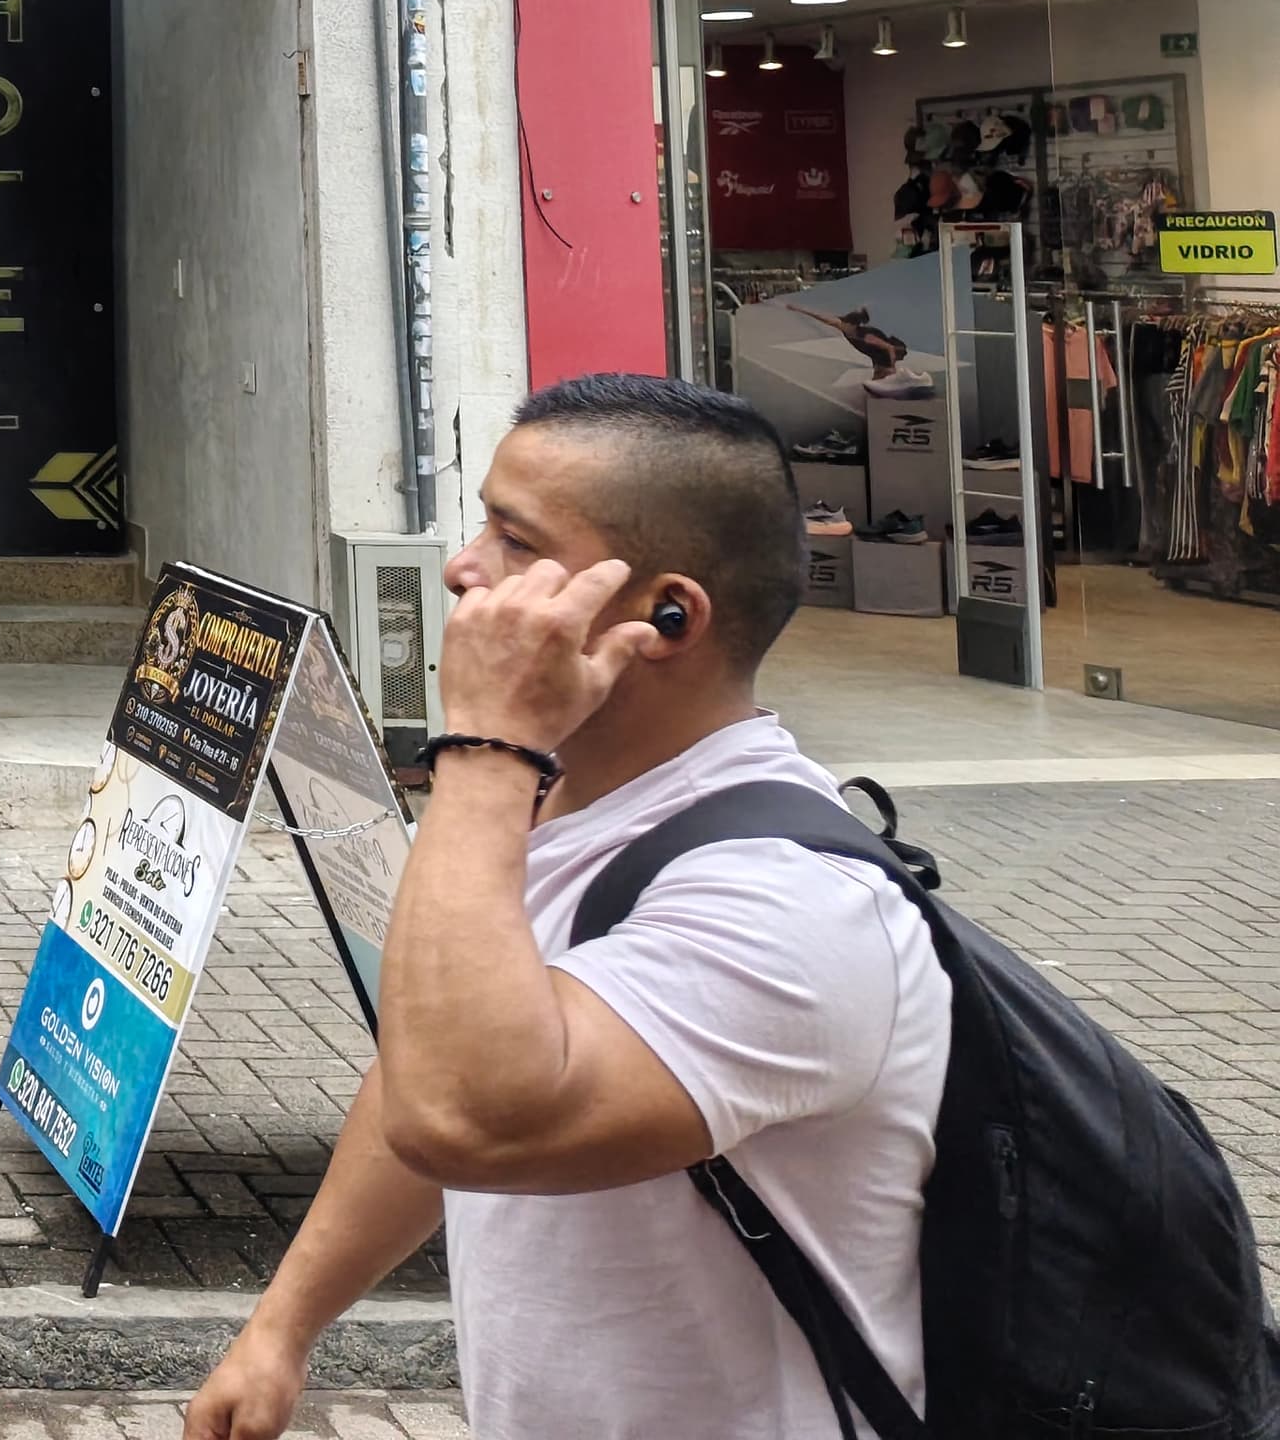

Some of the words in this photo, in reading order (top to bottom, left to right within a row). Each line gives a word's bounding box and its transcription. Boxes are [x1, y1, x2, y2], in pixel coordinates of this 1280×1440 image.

[1166, 215, 1266, 228] PRECAUCION
[1178, 245, 1254, 259] VIDRIO
[195, 611, 282, 680] COMPRAVENTA
[201, 713, 236, 738] DOLLAR
[118, 807, 201, 898] REPRESENTACIONES
[134, 858, 166, 892] Soto
[89, 908, 114, 952] 321
[111, 926, 138, 973] 776
[135, 946, 173, 1002] 7266
[40, 1006, 83, 1061] GOLDEN
[83, 1046, 120, 1101] VISION
[17, 1069, 40, 1110] 320
[33, 1086, 55, 1137] 841
[48, 1102, 78, 1159] 7532
